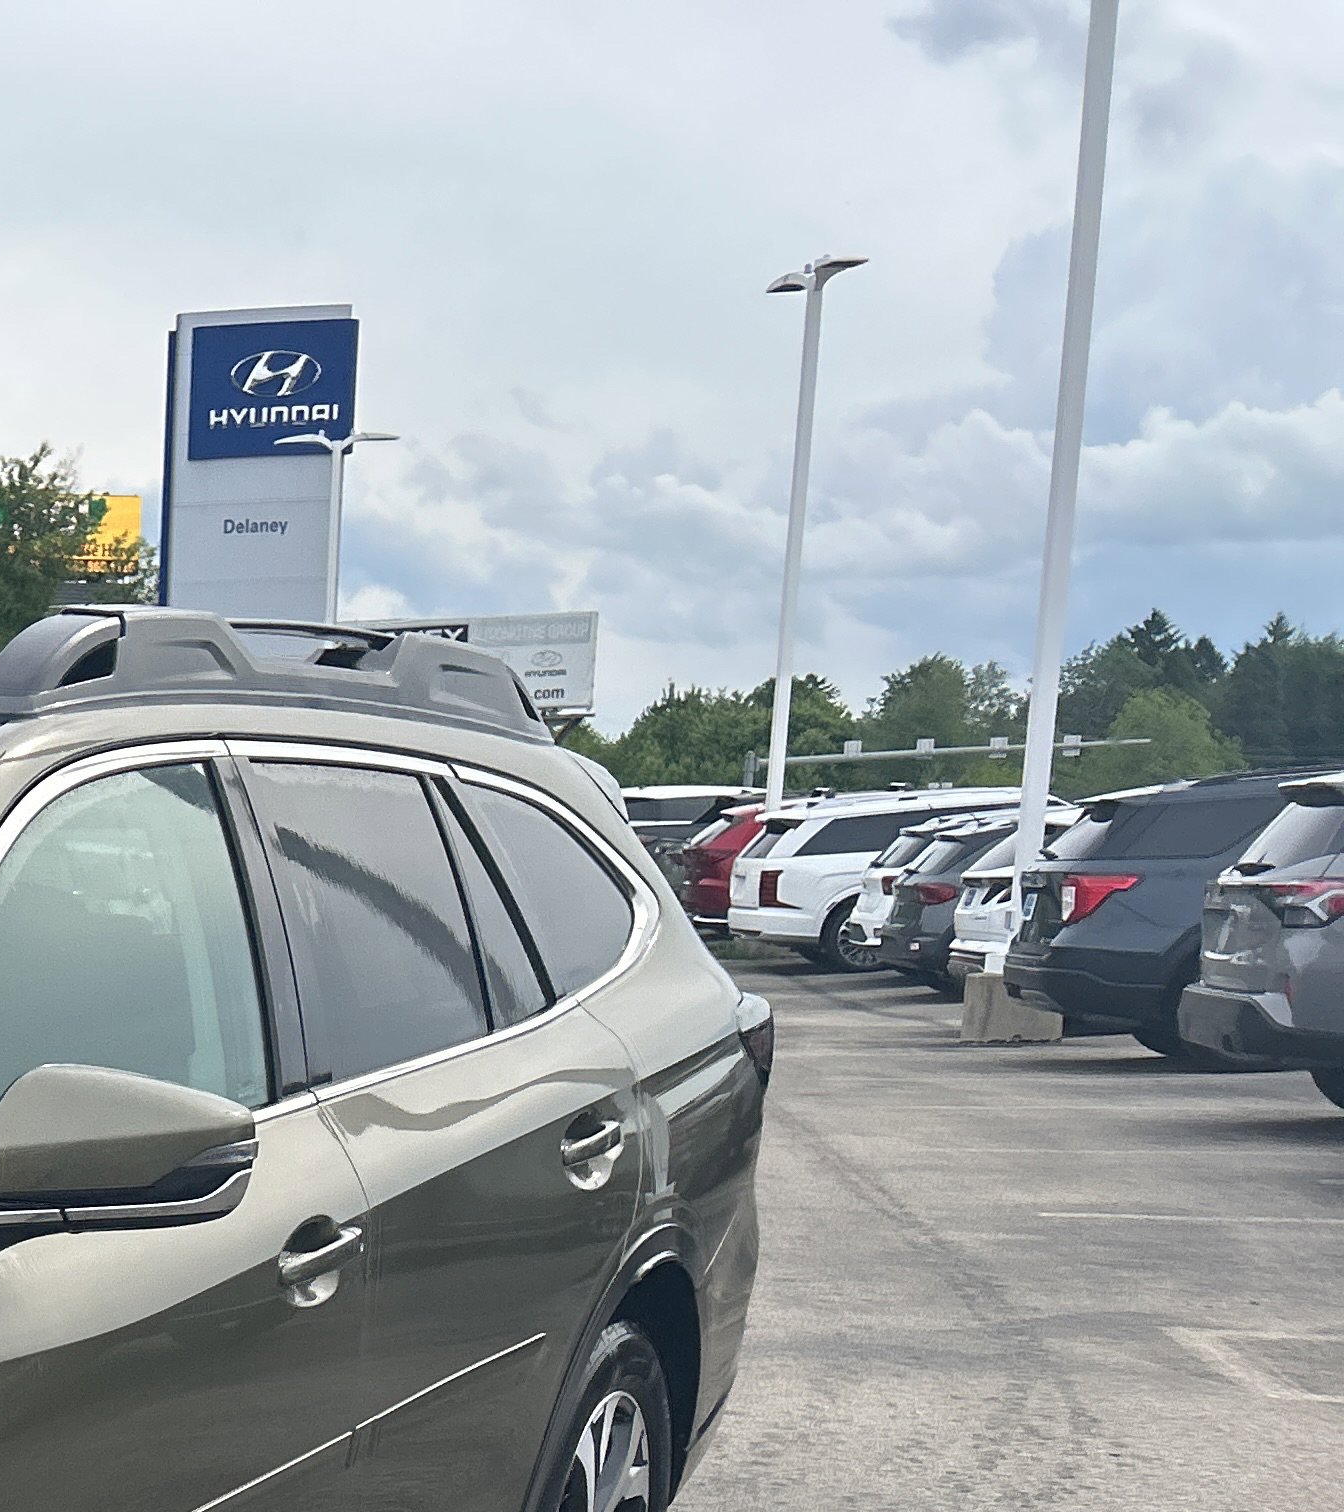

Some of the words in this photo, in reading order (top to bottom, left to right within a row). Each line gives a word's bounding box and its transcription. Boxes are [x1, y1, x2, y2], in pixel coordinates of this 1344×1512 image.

[209, 403, 339, 427] HYUNDAI
[223, 517, 288, 536] Delaney
[524, 669, 567, 678] HYUNDAI
